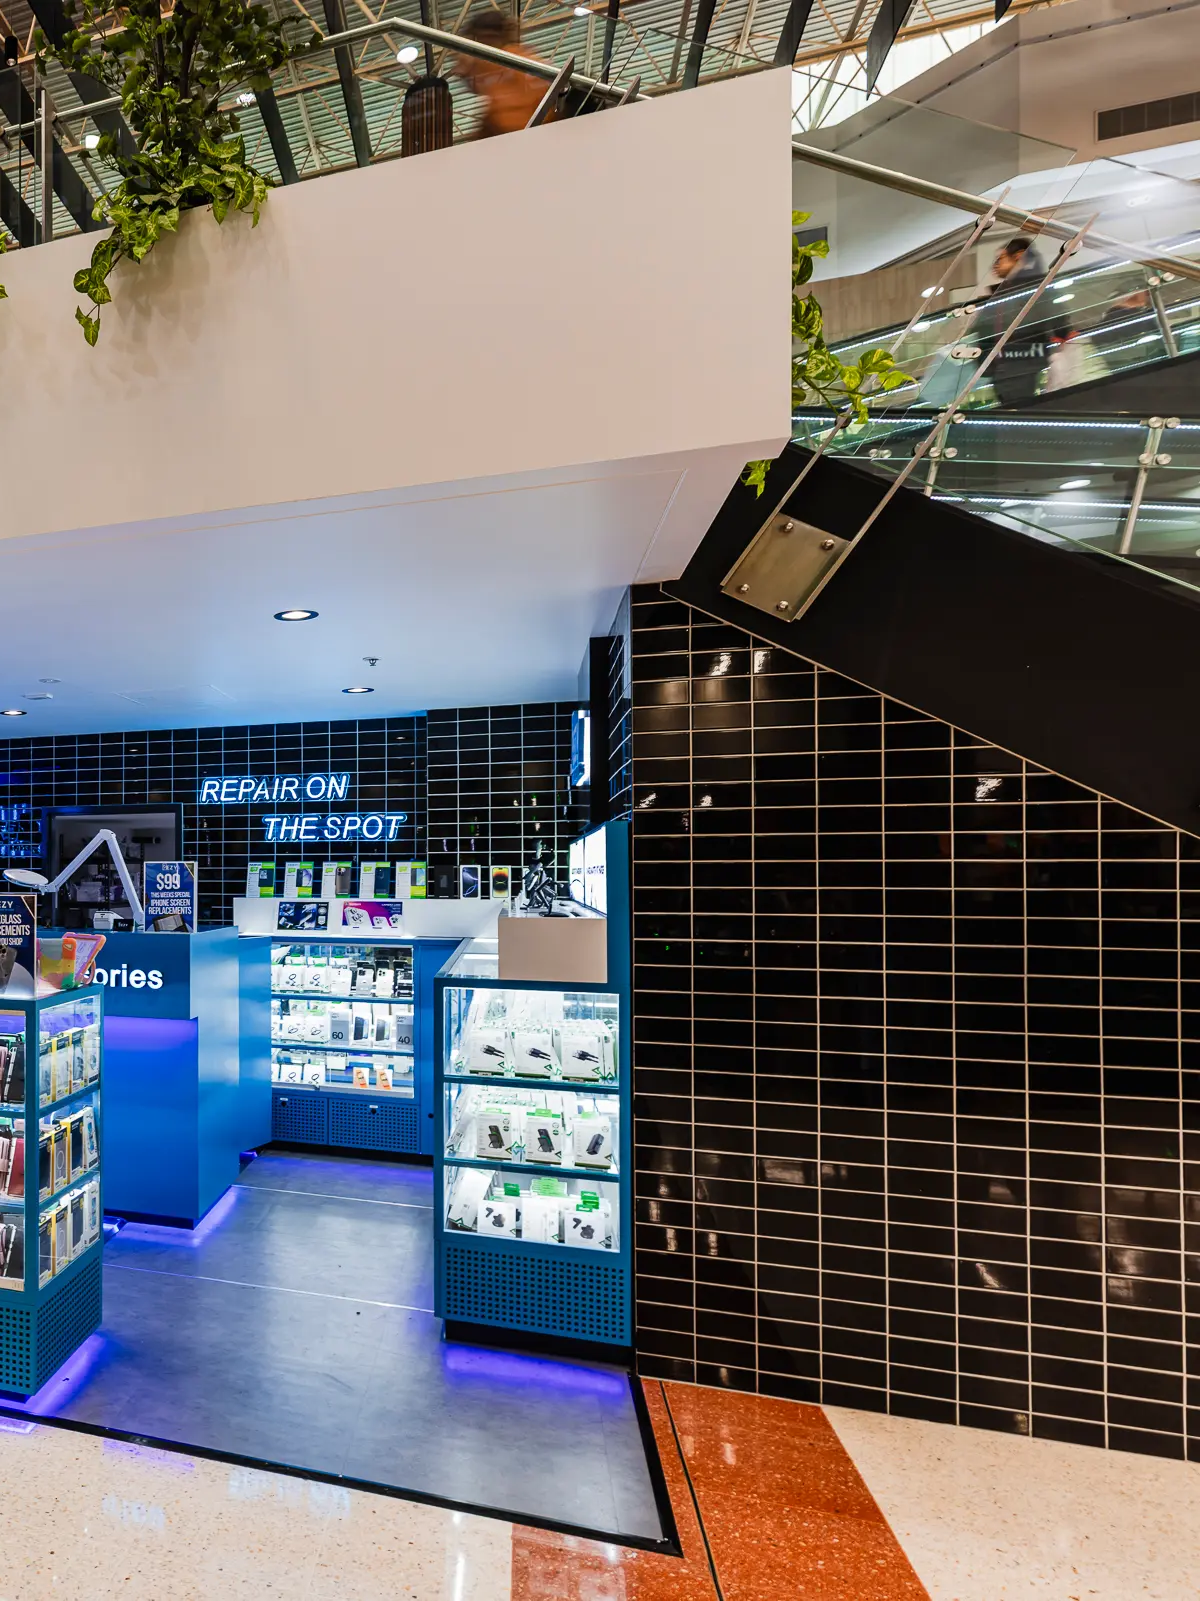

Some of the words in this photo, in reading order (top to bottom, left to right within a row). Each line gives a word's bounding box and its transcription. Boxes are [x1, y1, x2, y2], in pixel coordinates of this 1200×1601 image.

[201, 778, 299, 803] REPAIR
[306, 774, 348, 800] ON
[264, 817, 319, 840] THE
[323, 814, 405, 840] SPOT
[156, 873, 180, 890] $99
[148, 907, 192, 915] REPLACEMENTS
[332, 1031, 344, 1040] 60
[398, 1035, 411, 1044] 40
